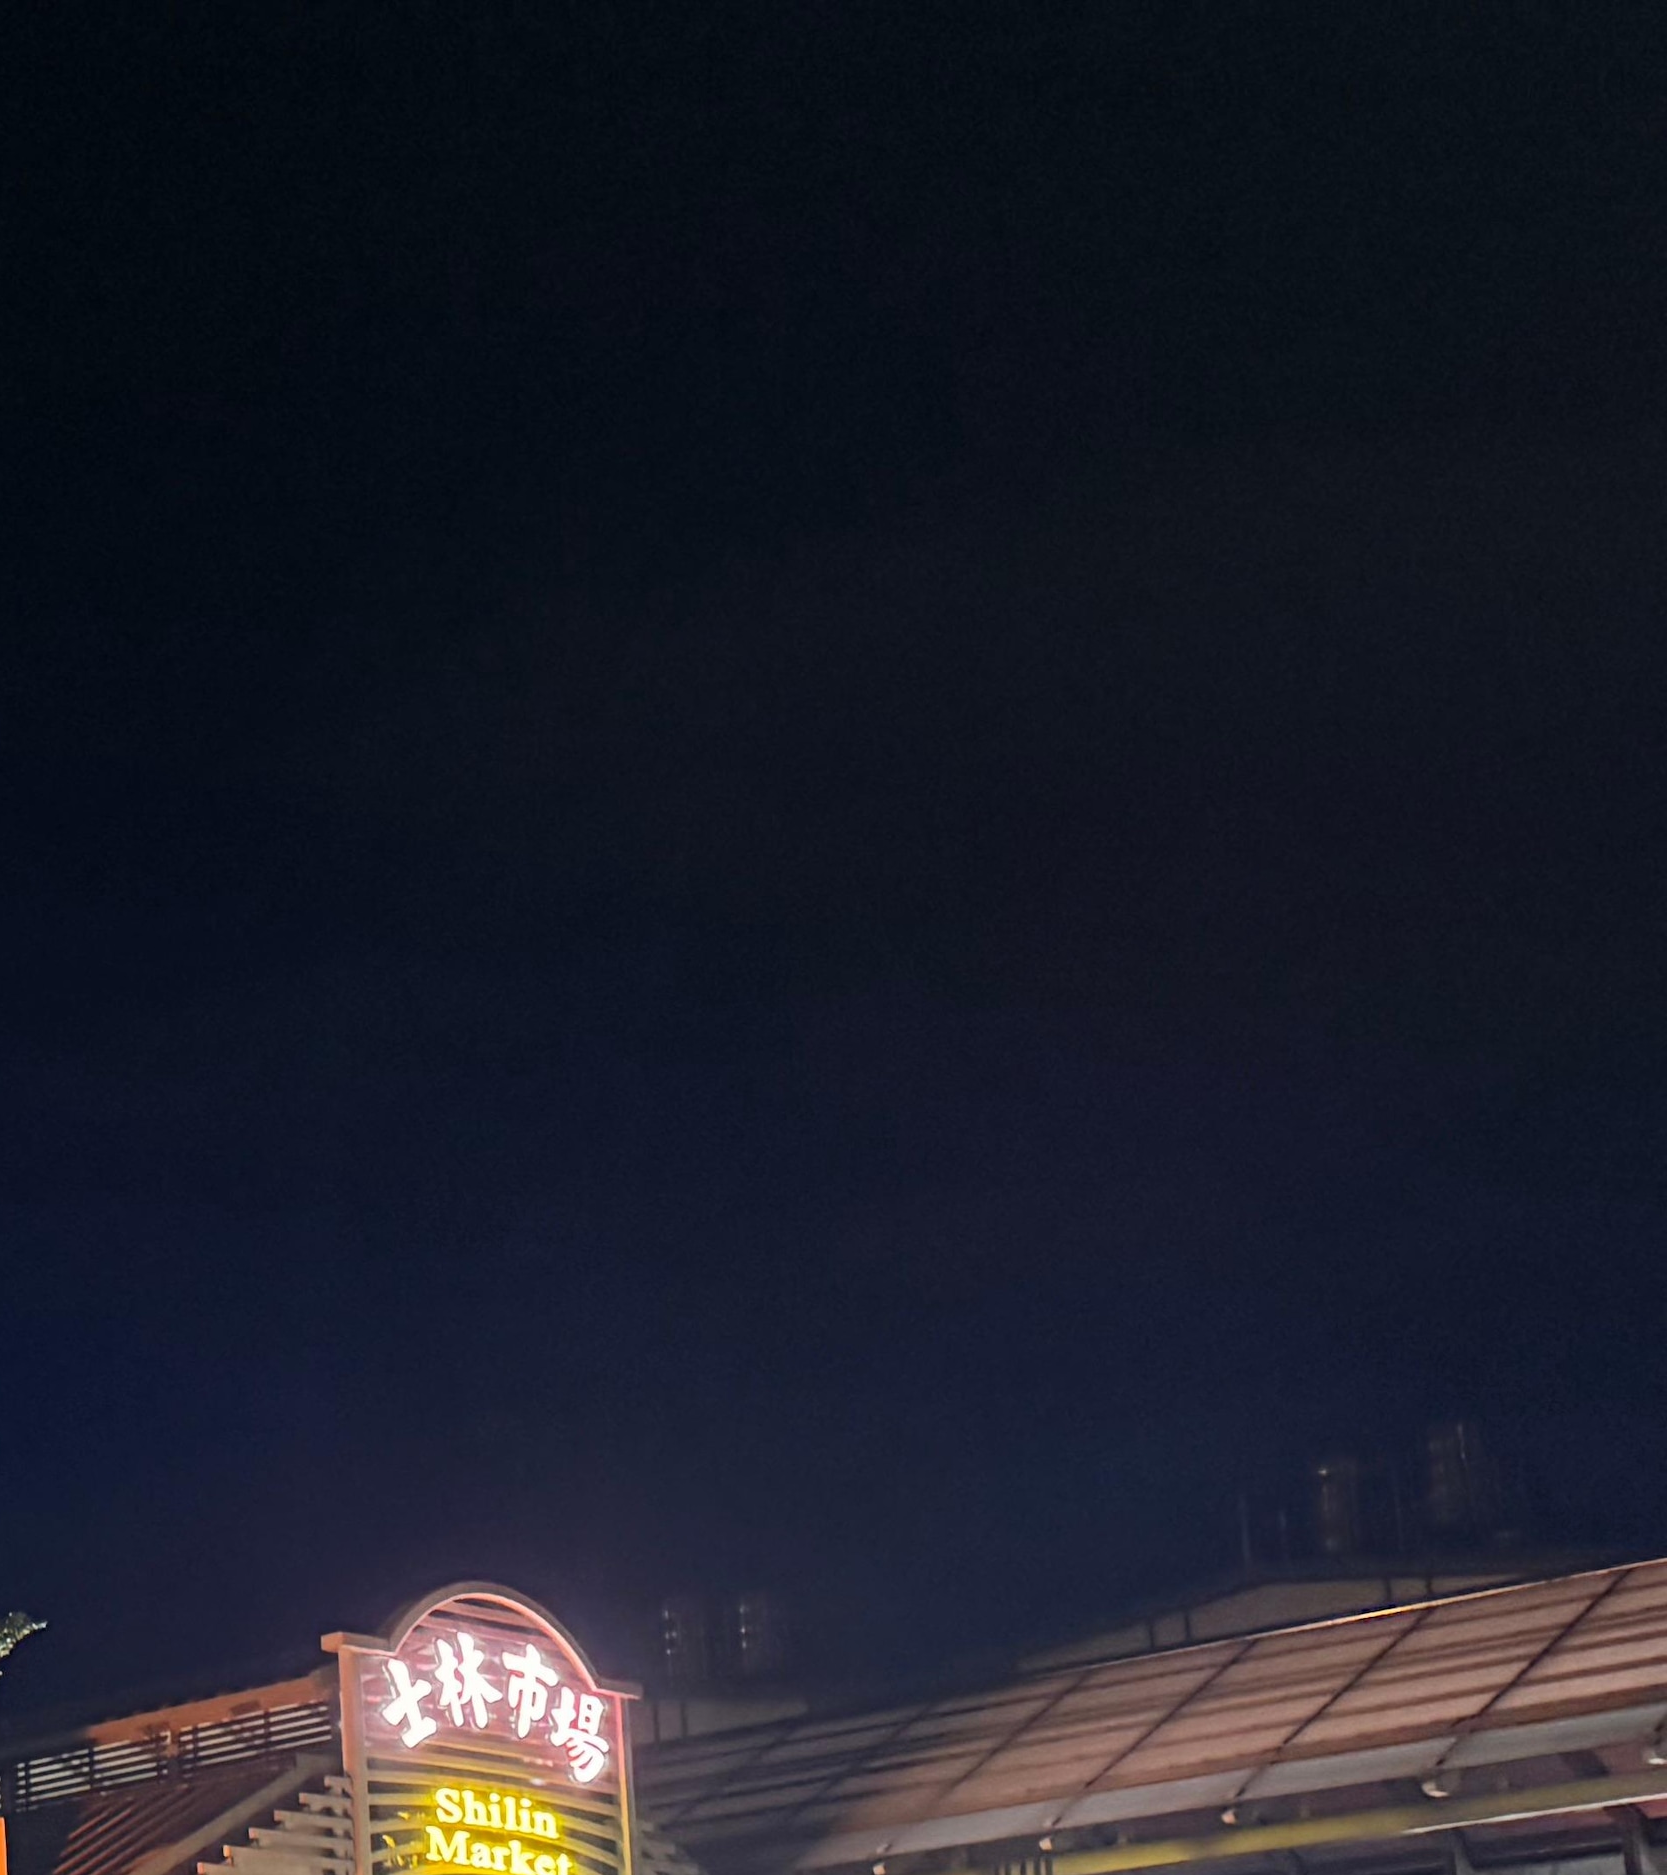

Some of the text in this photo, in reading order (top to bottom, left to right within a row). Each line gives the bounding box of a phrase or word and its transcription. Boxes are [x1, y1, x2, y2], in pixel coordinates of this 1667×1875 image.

[382, 1632, 611, 1783] 士林市場
[434, 1787, 560, 1839] Shilin
